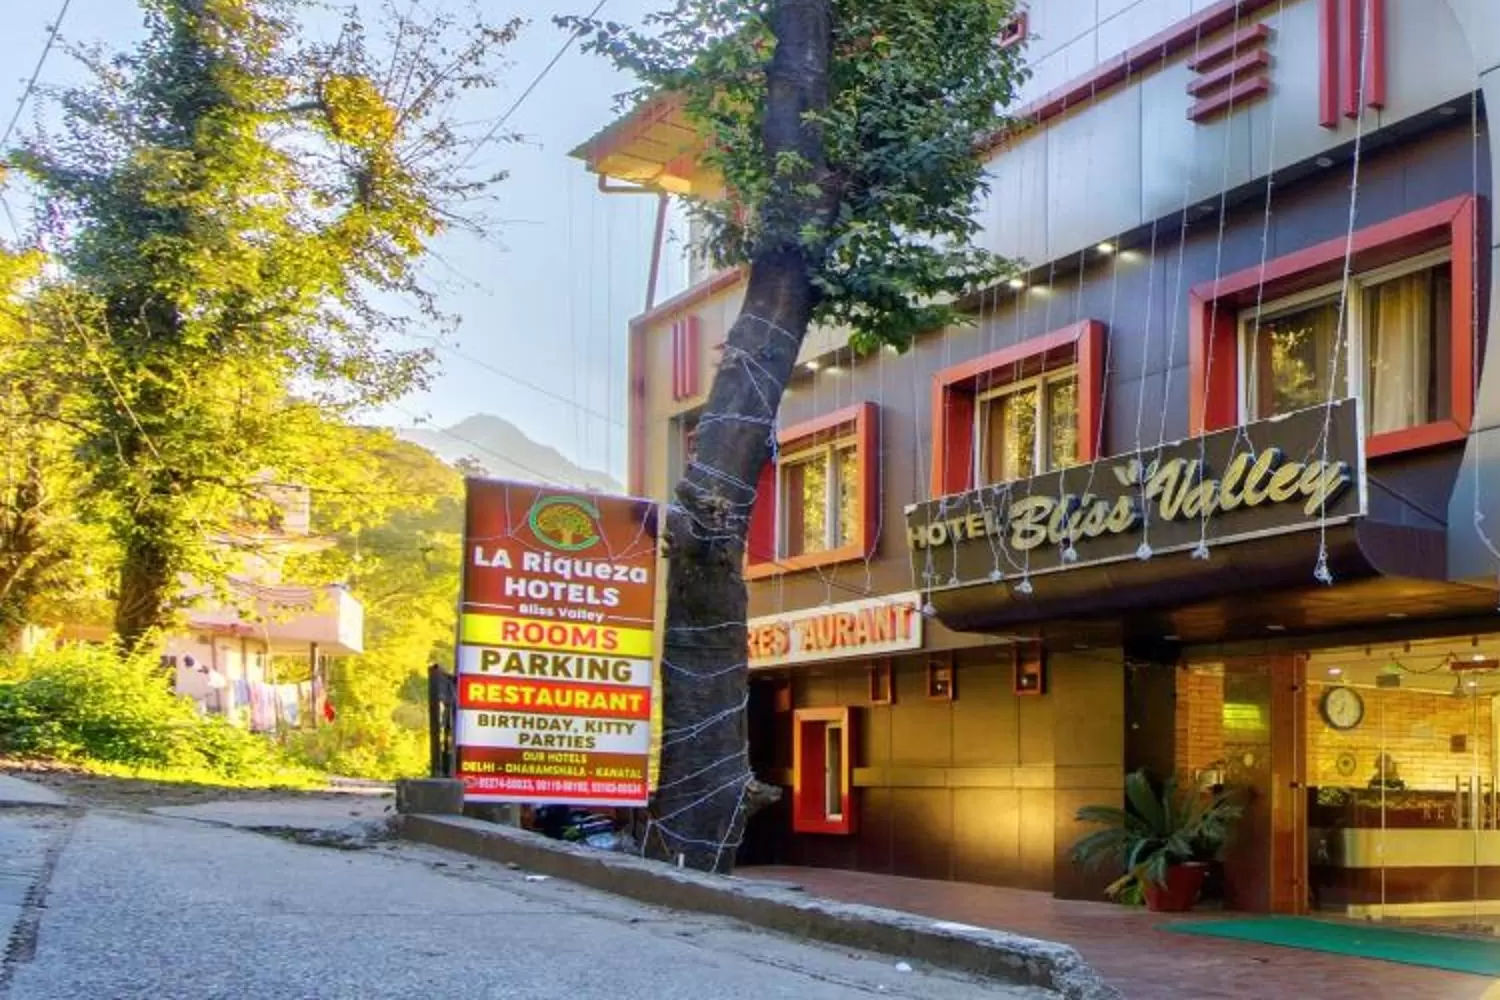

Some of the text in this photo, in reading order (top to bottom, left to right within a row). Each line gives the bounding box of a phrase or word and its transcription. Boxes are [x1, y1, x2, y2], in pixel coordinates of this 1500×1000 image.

[906, 448, 1350, 550] HOTEL Bliss Valley
[474, 546, 648, 584] LA Riqueza
[505, 576, 620, 607] HOTELS
[519, 604, 605, 622] Bliss Valley
[501, 620, 619, 650] ROOMS
[480, 650, 632, 682] PARKING
[468, 683, 643, 712] RESTAURANT
[519, 733, 596, 749] PARTIES
[585, 721, 636, 735] KITTY
[462, 761, 494, 772] DELHI
[523, 752, 587, 764] OUR HOTELS
